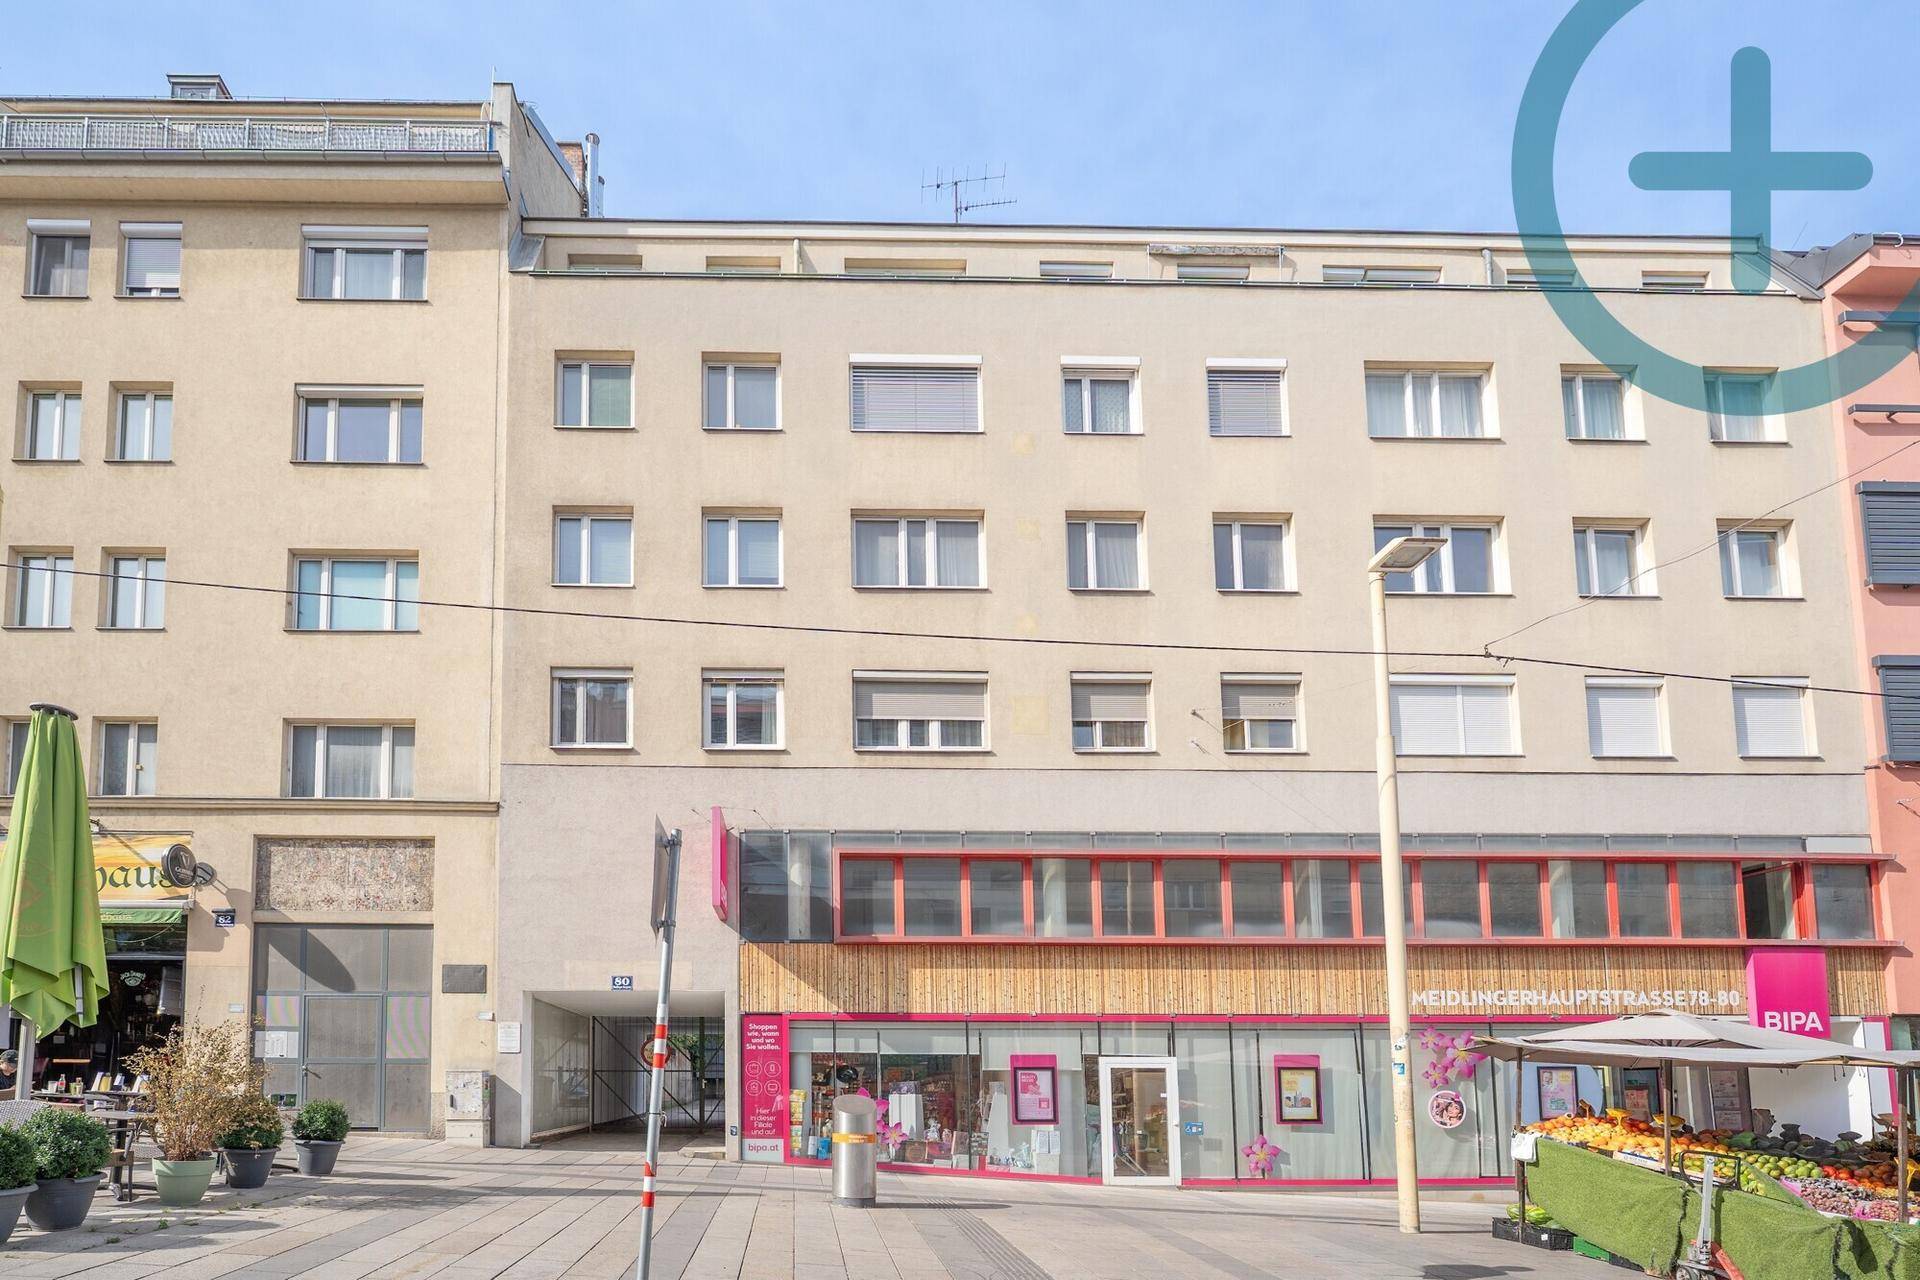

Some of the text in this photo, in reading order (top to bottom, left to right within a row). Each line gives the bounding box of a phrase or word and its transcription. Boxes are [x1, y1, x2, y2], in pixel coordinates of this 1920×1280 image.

[218, 916, 231, 924] 82
[614, 976, 630, 986] 80
[1764, 1011, 1824, 1032] BIPA
[748, 1023, 778, 1031] Shoppen
[748, 1143, 779, 1153] bipa.at
